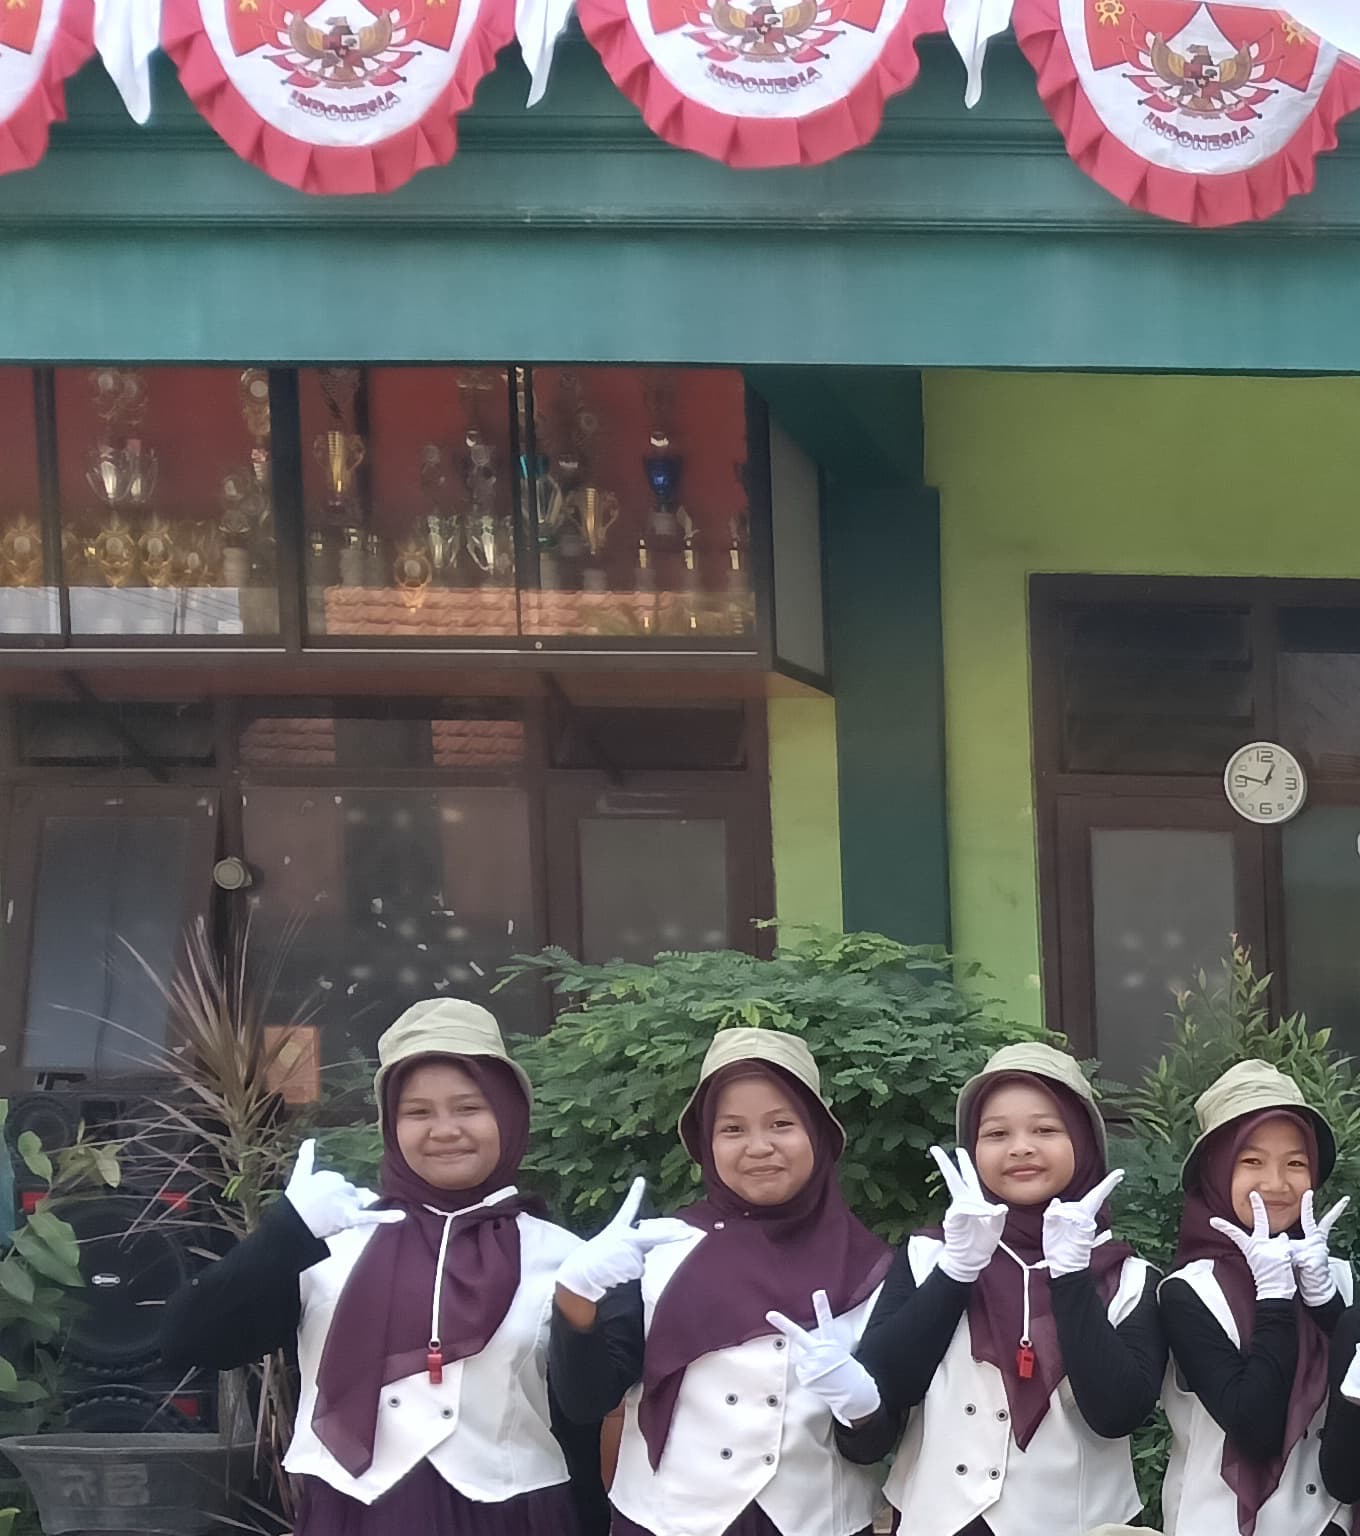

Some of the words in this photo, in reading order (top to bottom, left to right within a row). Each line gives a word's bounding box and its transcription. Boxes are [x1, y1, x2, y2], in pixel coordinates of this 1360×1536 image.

[705, 63, 823, 94] INDONESIA
[288, 90, 401, 122] INDONESIA
[1143, 111, 1255, 151] INDONESIA
[1256, 750, 1274, 763] 12
[1259, 802, 1273, 815] 6
